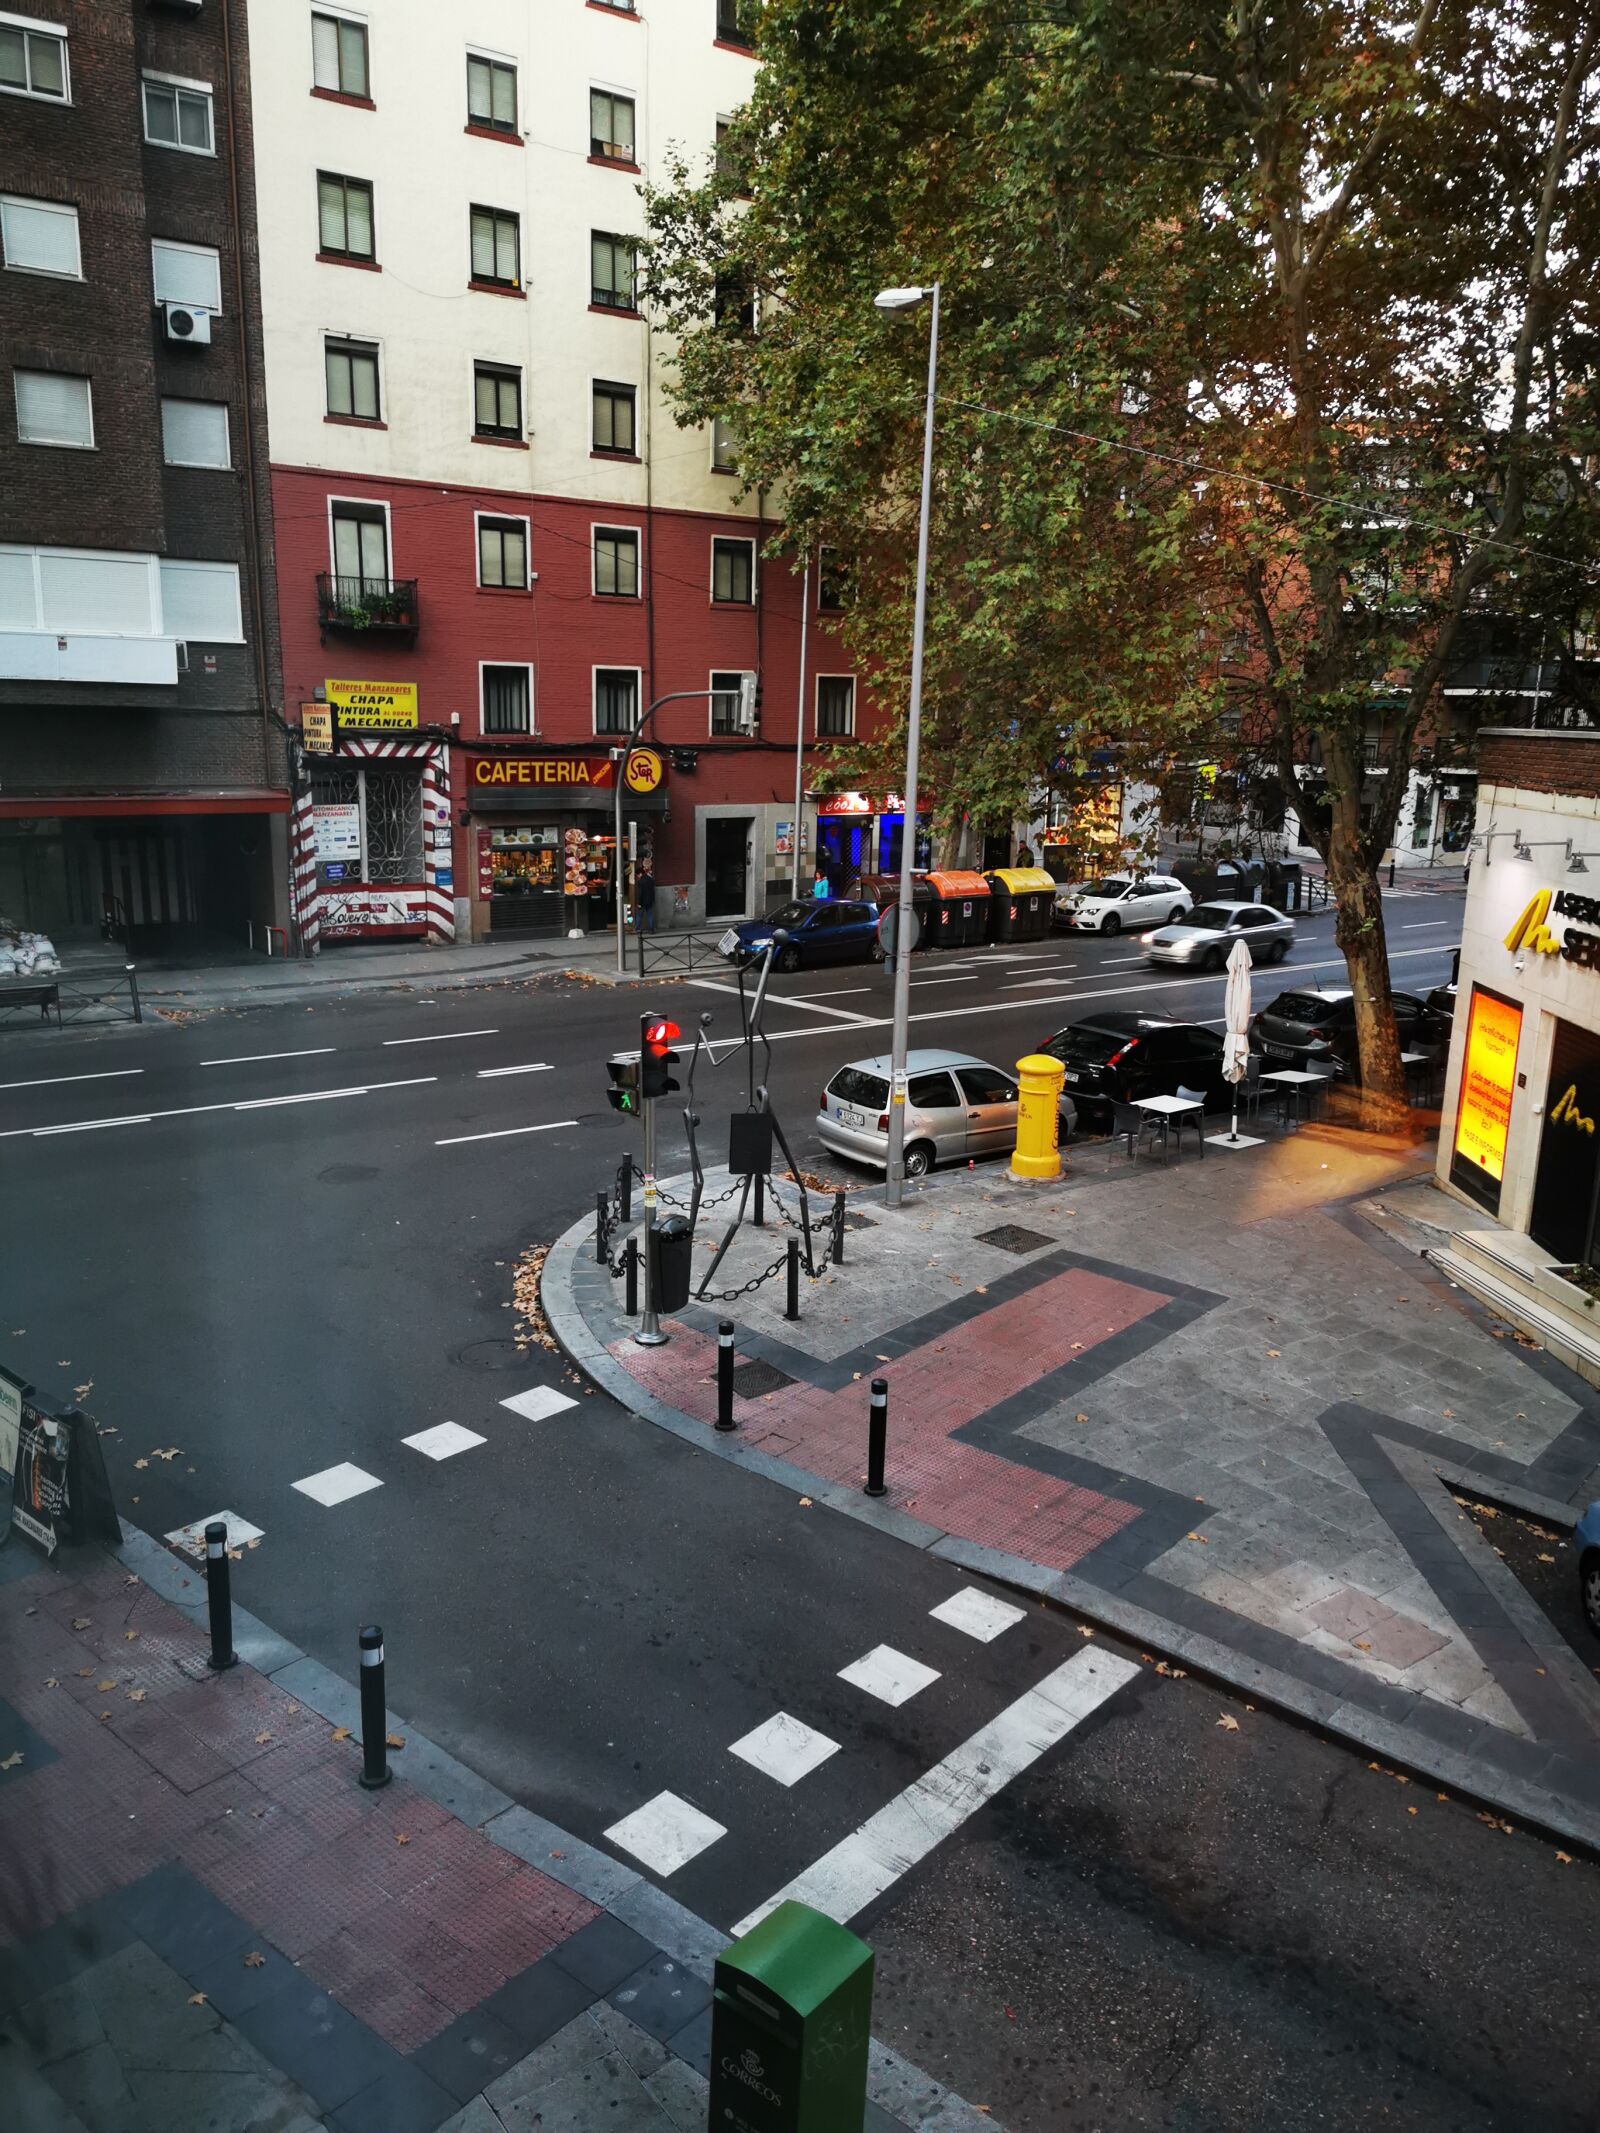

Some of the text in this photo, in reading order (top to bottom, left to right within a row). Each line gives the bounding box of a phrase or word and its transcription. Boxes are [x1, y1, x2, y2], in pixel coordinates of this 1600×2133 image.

[332, 682, 412, 694] Talleres Manzanares
[350, 695, 394, 705] CHAPA
[310, 716, 326, 726] CHAPA
[345, 718, 412, 728] MECANICA
[475, 761, 590, 783] CAFETERIA
[721, 2056, 782, 2106] CORREOS
